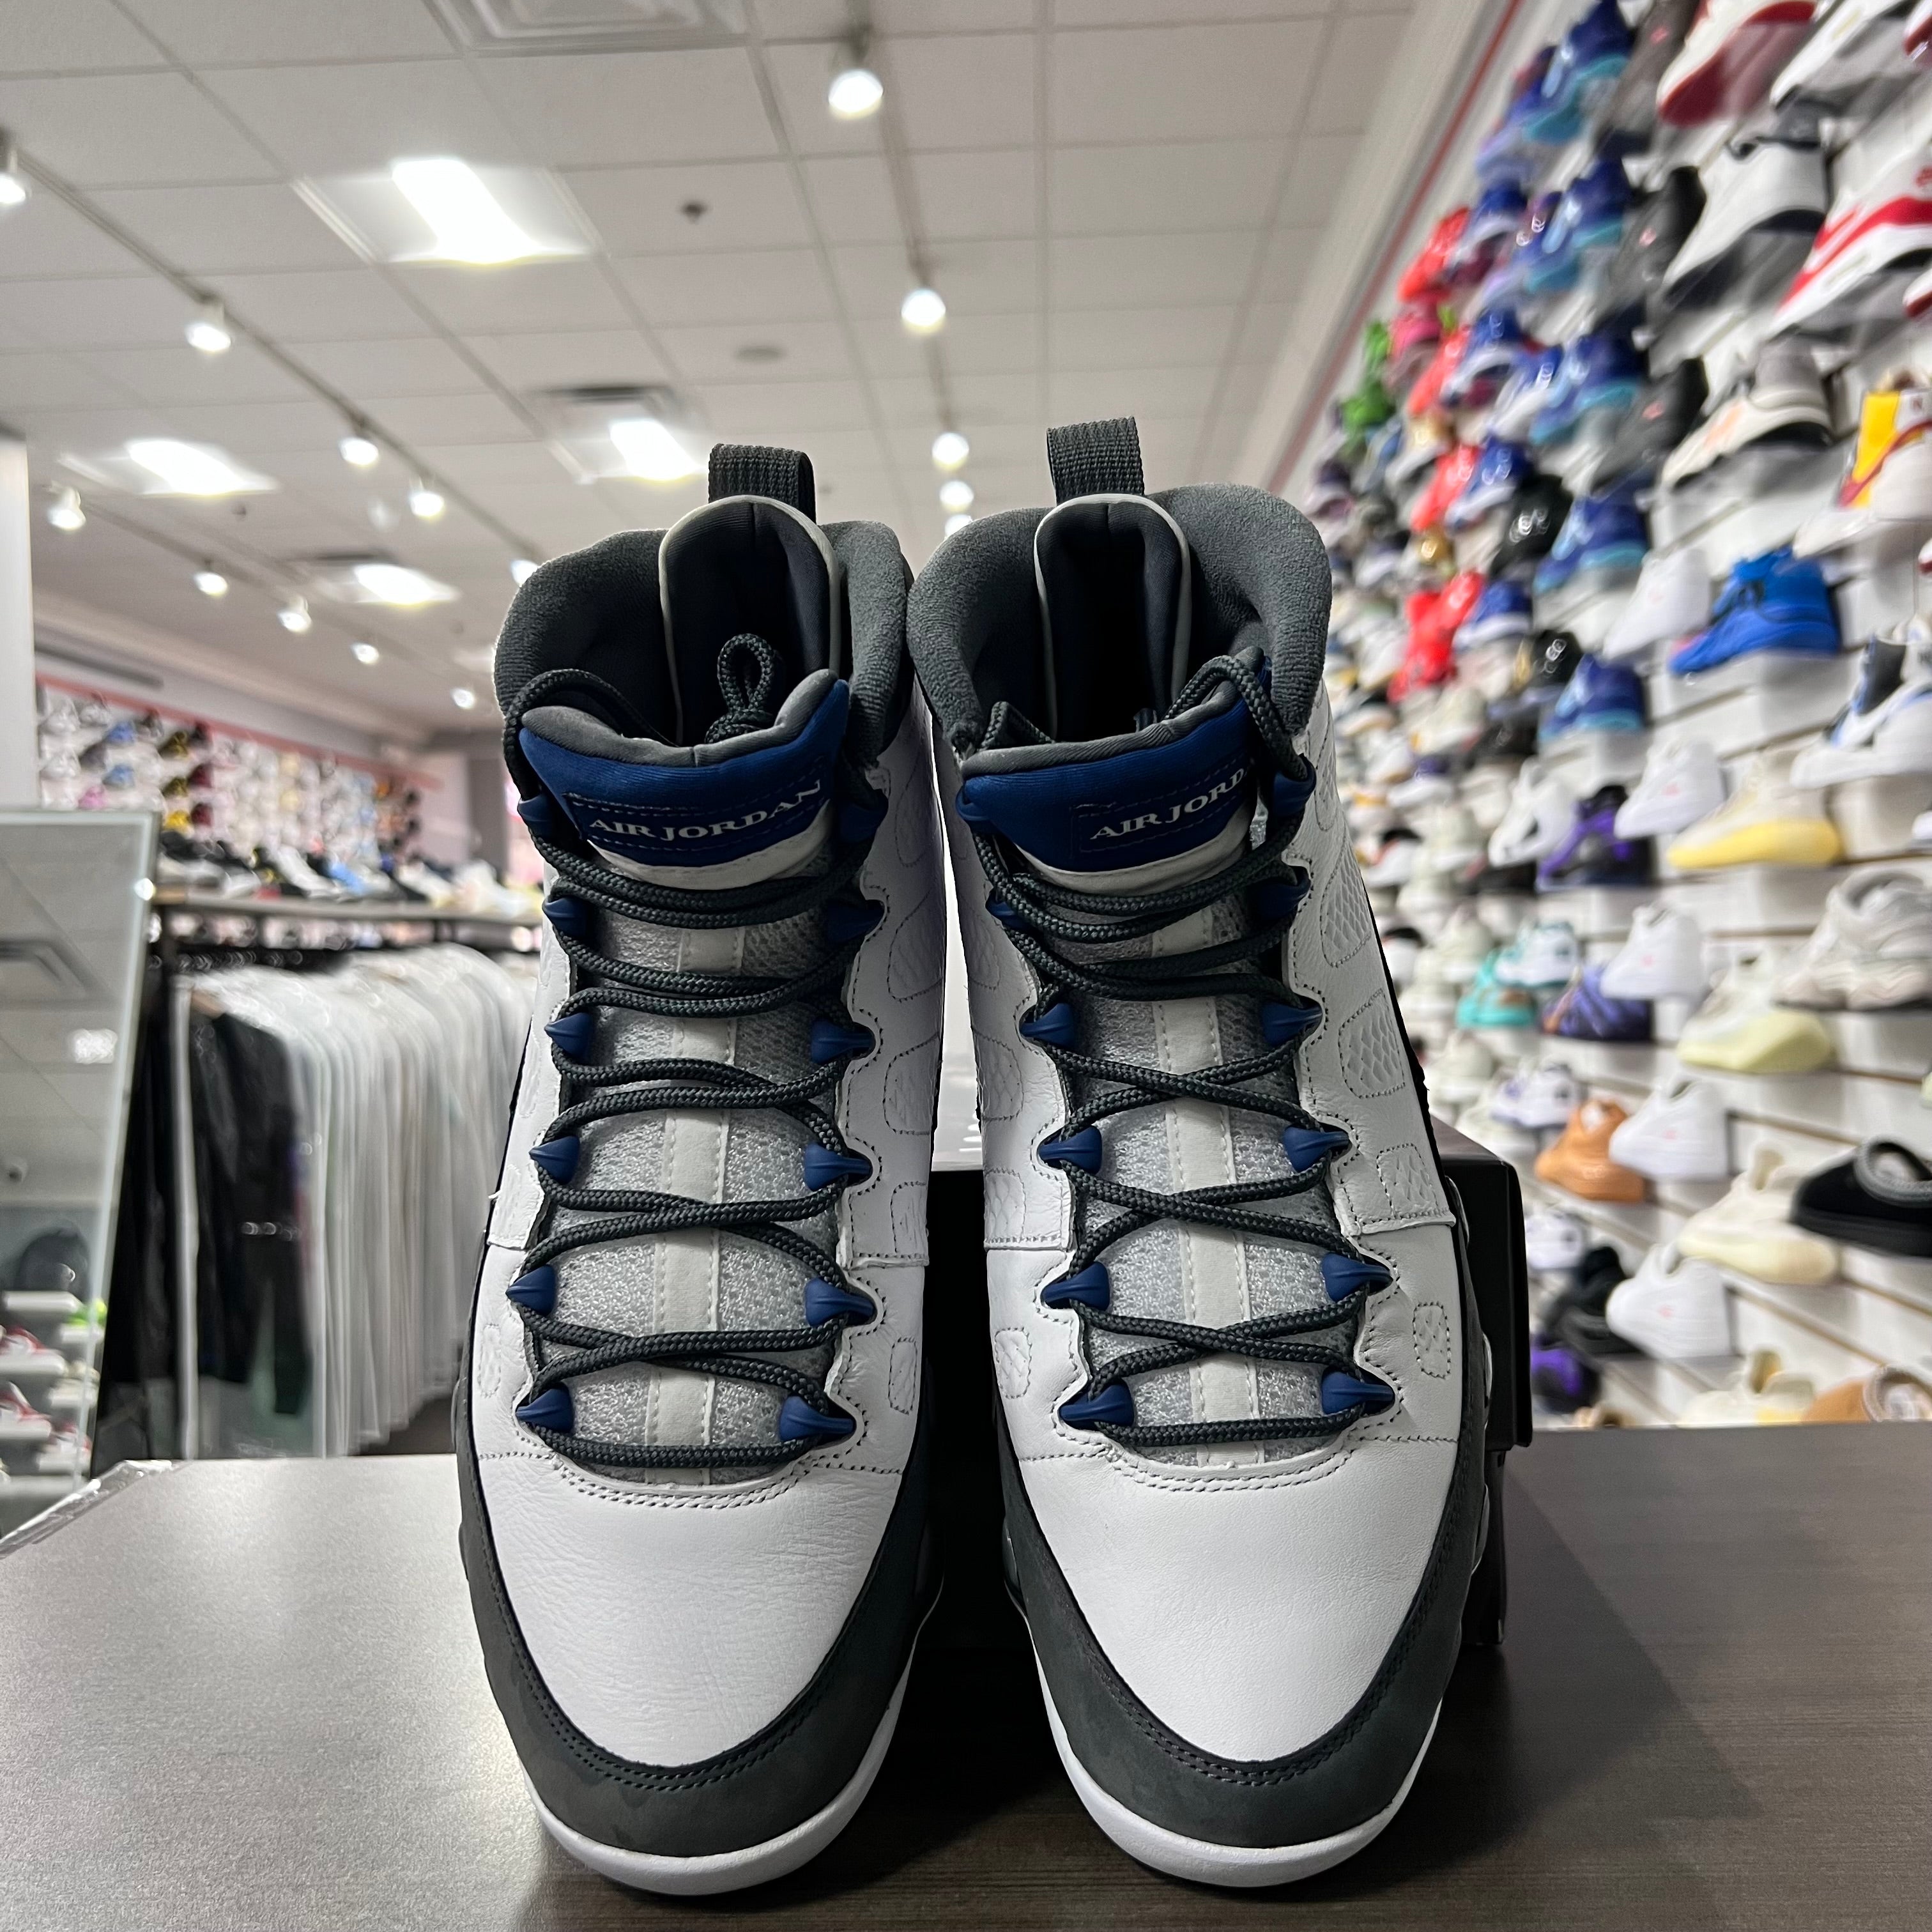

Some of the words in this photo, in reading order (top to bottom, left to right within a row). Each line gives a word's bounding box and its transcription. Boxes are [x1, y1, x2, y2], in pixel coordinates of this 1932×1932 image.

[589, 819, 657, 838] AIR
[659, 779, 821, 841] JORDAN
[1090, 813, 1162, 840] AIR
[1165, 768, 1246, 824] JORD
